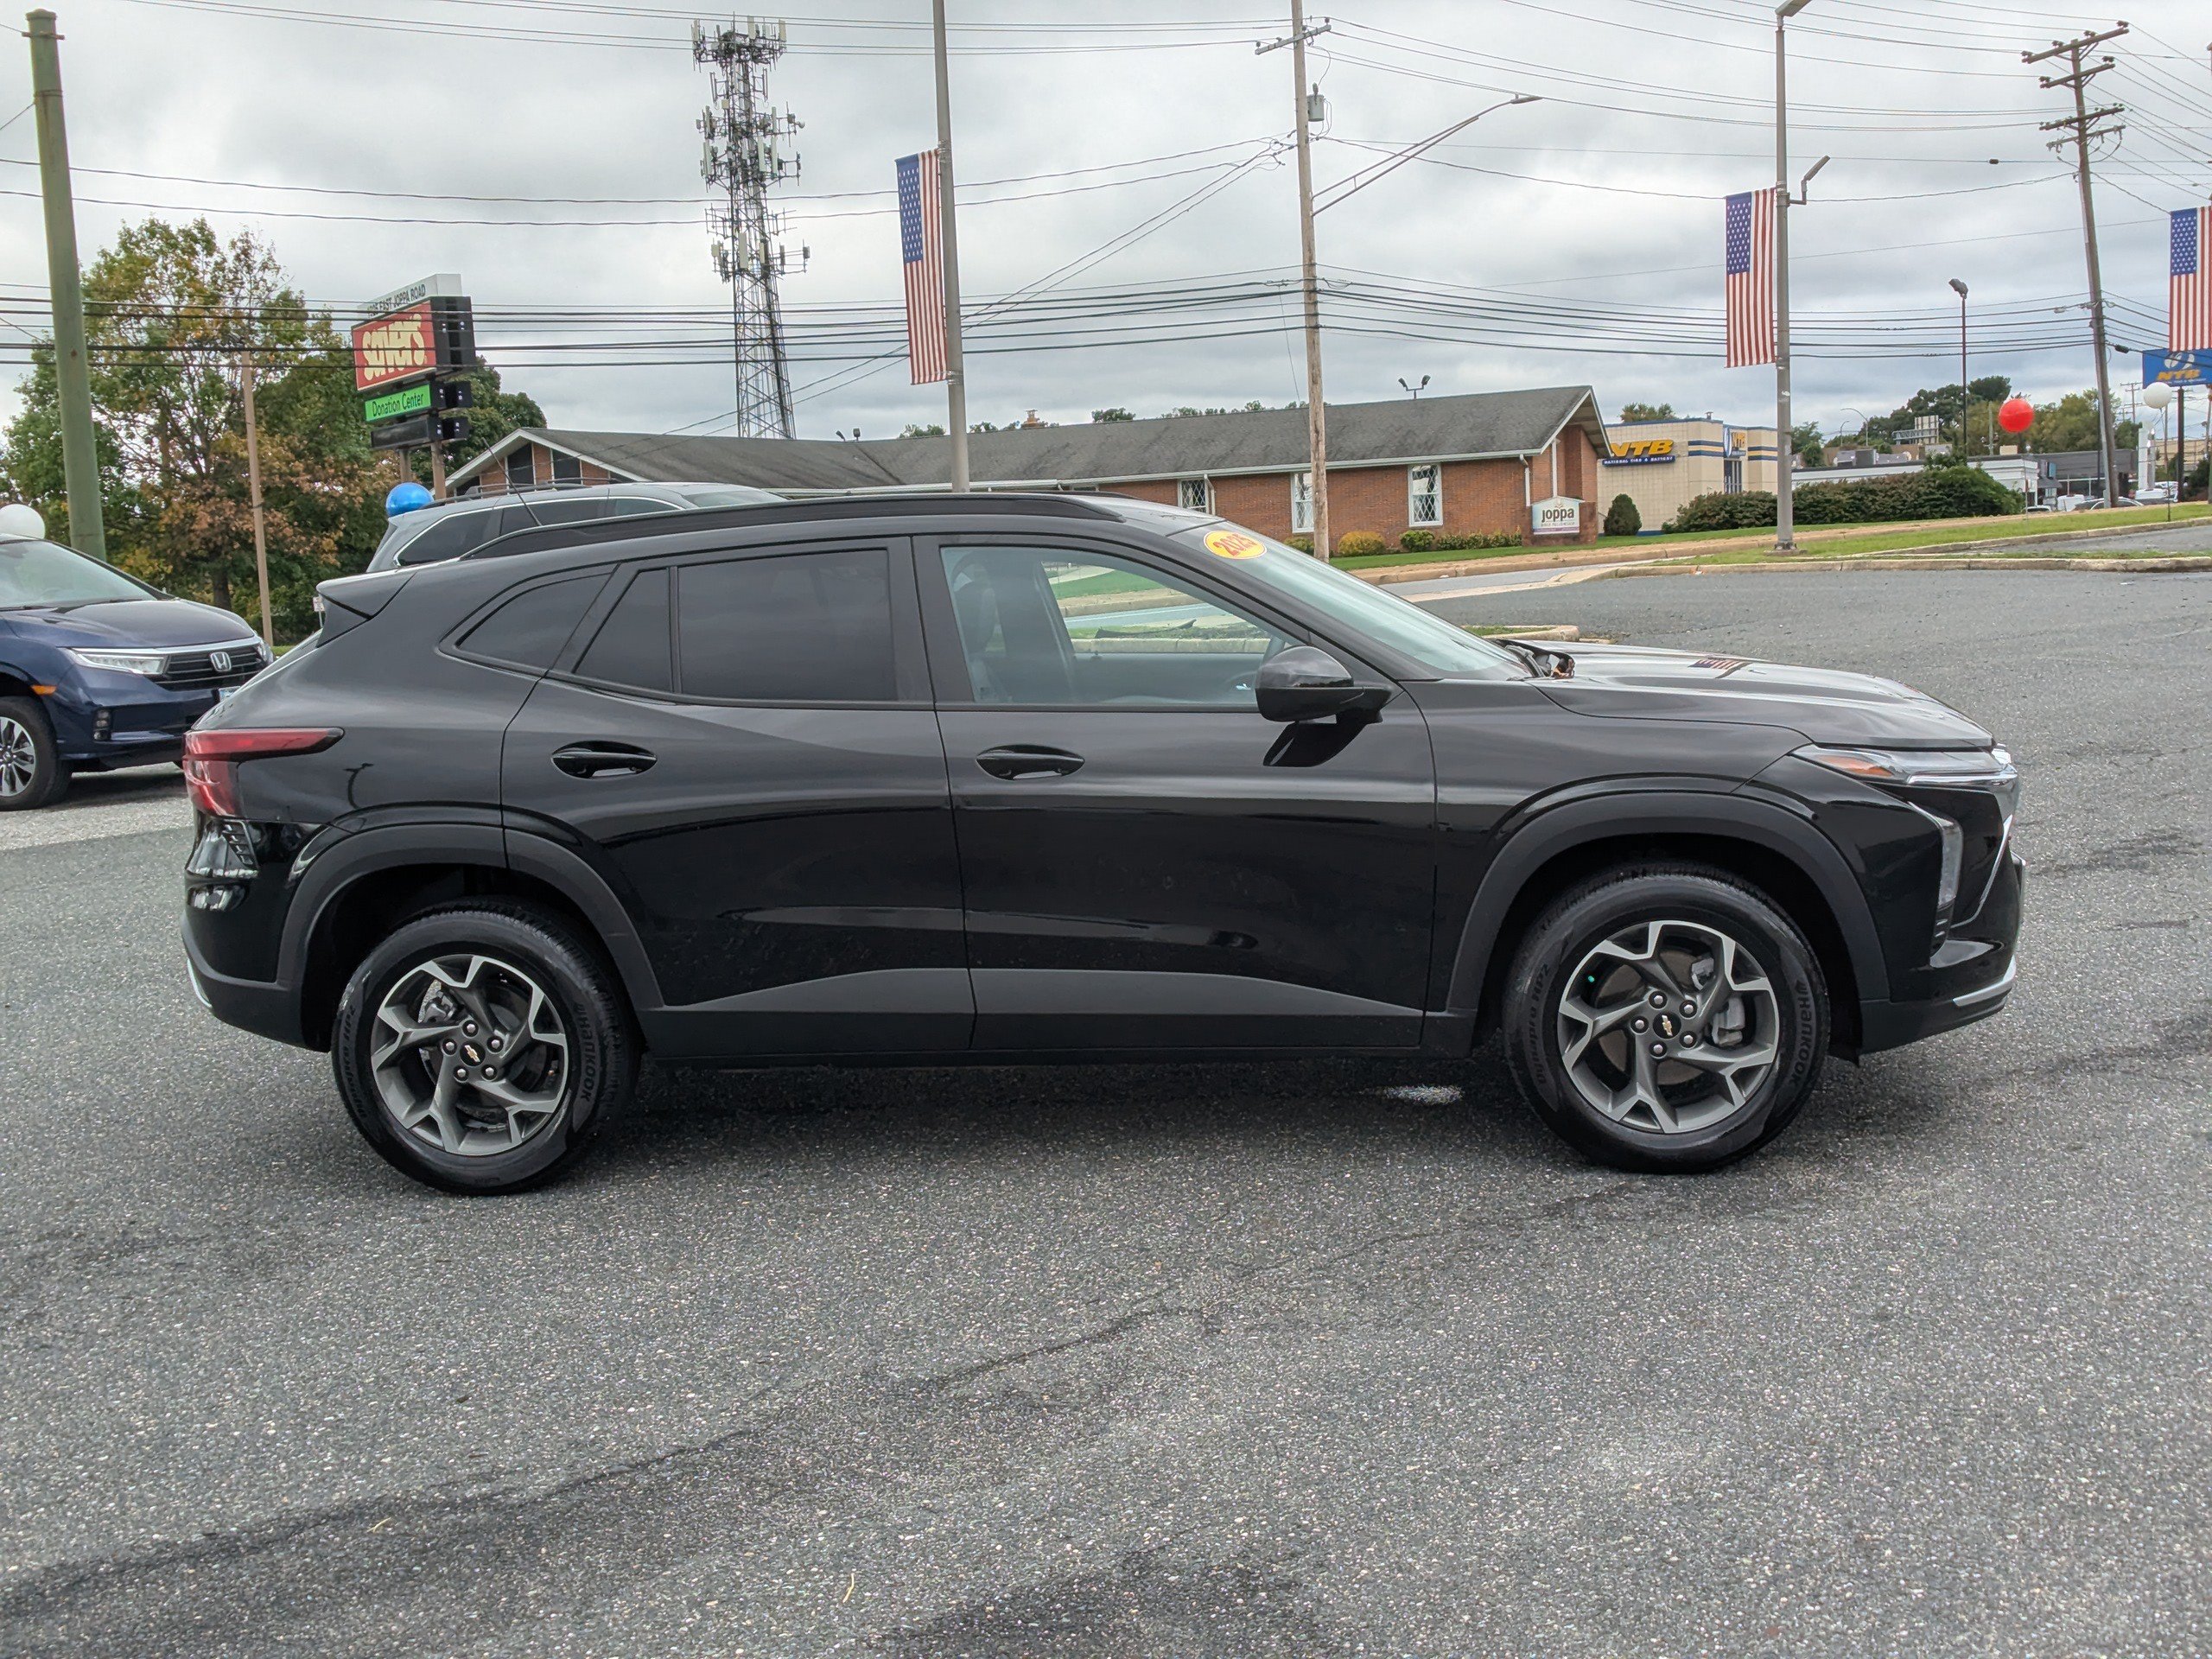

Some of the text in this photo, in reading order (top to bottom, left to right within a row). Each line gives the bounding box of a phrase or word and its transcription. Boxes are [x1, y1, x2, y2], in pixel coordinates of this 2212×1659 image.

[410, 283, 426, 301] ROAD
[2156, 369, 2201, 380] NTB
[372, 392, 423, 416] Donation Center
[1541, 508, 1574, 523] joppa
[1213, 533, 1257, 556] 2025
